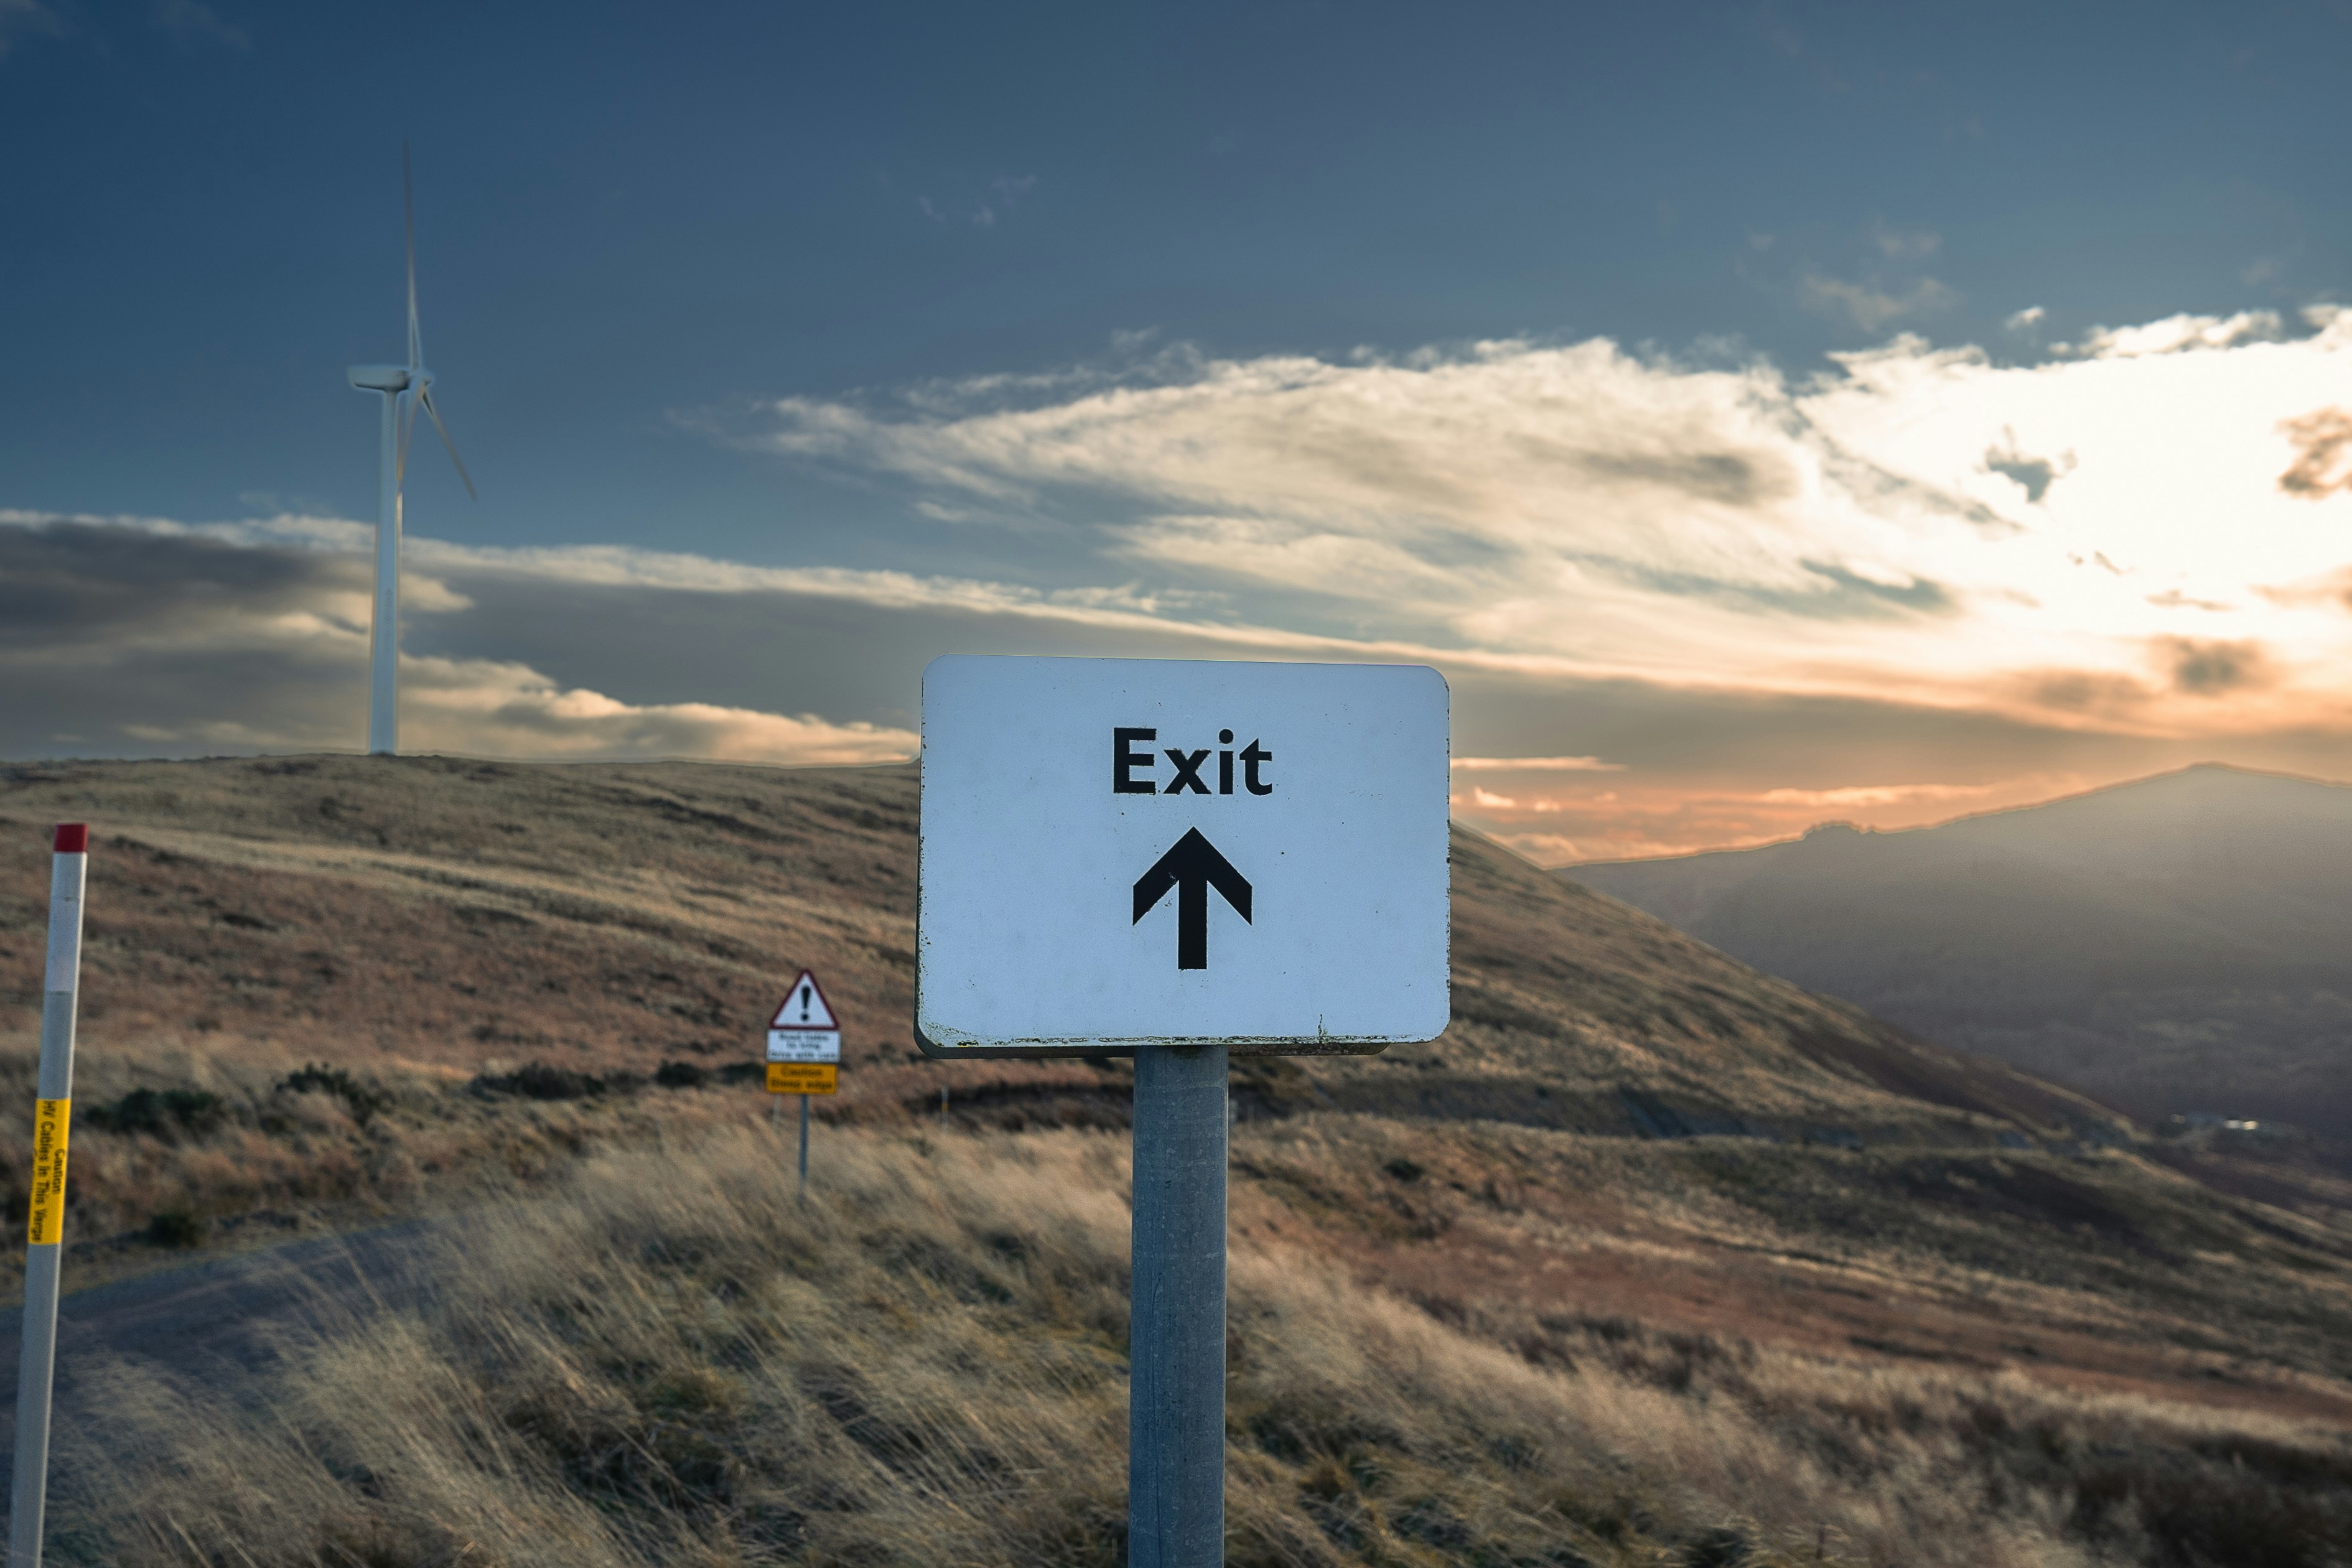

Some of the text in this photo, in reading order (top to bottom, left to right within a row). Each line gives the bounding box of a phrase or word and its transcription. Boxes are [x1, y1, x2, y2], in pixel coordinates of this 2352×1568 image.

[1113, 727, 1273, 796] Exit
[42, 1100, 56, 1118] HV
[38, 1121, 55, 1162] Cables
[52, 1148, 66, 1195] Caution
[35, 1181, 50, 1205] This
[32, 1208, 47, 1243] Verge
